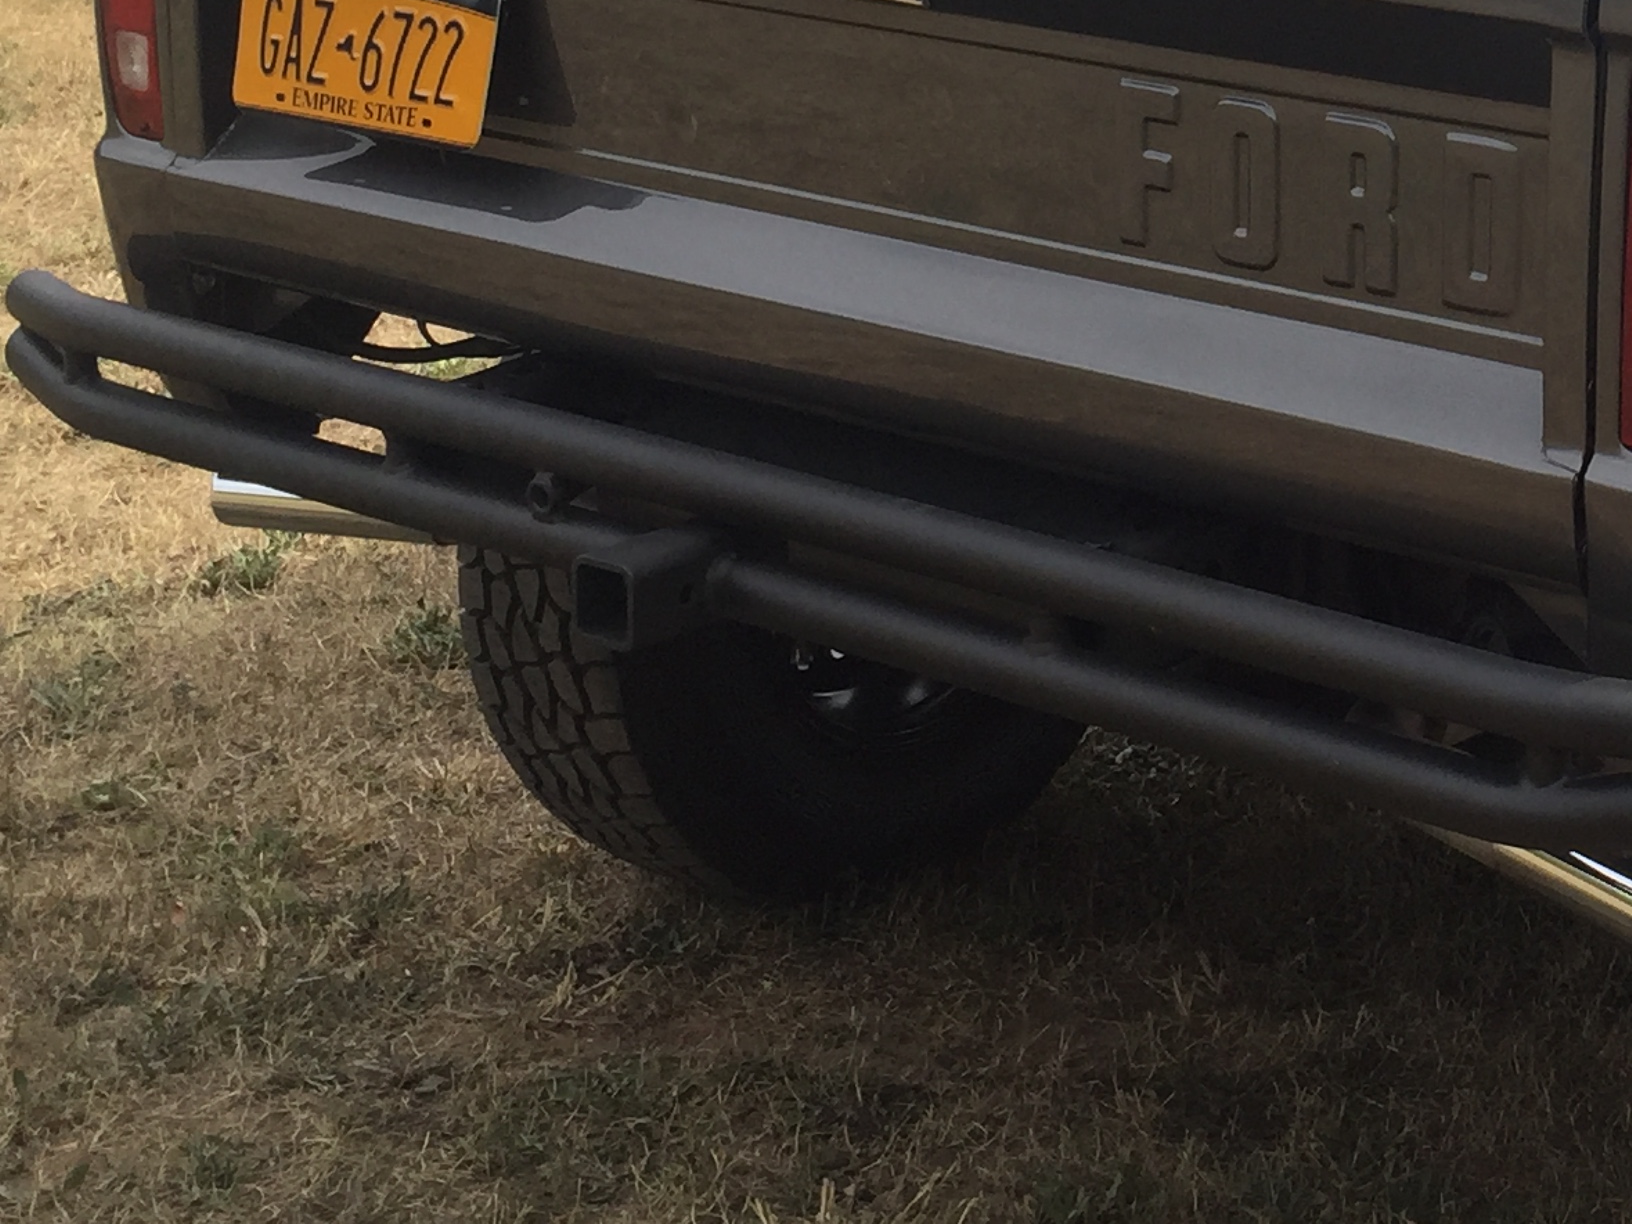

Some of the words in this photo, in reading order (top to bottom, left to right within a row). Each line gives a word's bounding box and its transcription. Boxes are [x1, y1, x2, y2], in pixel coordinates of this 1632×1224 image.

[292, 86, 358, 119] EMPIRE
[362, 103, 419, 129] STATE
[359, 7, 468, 108] 6722
[1119, 77, 1520, 318] FORD
